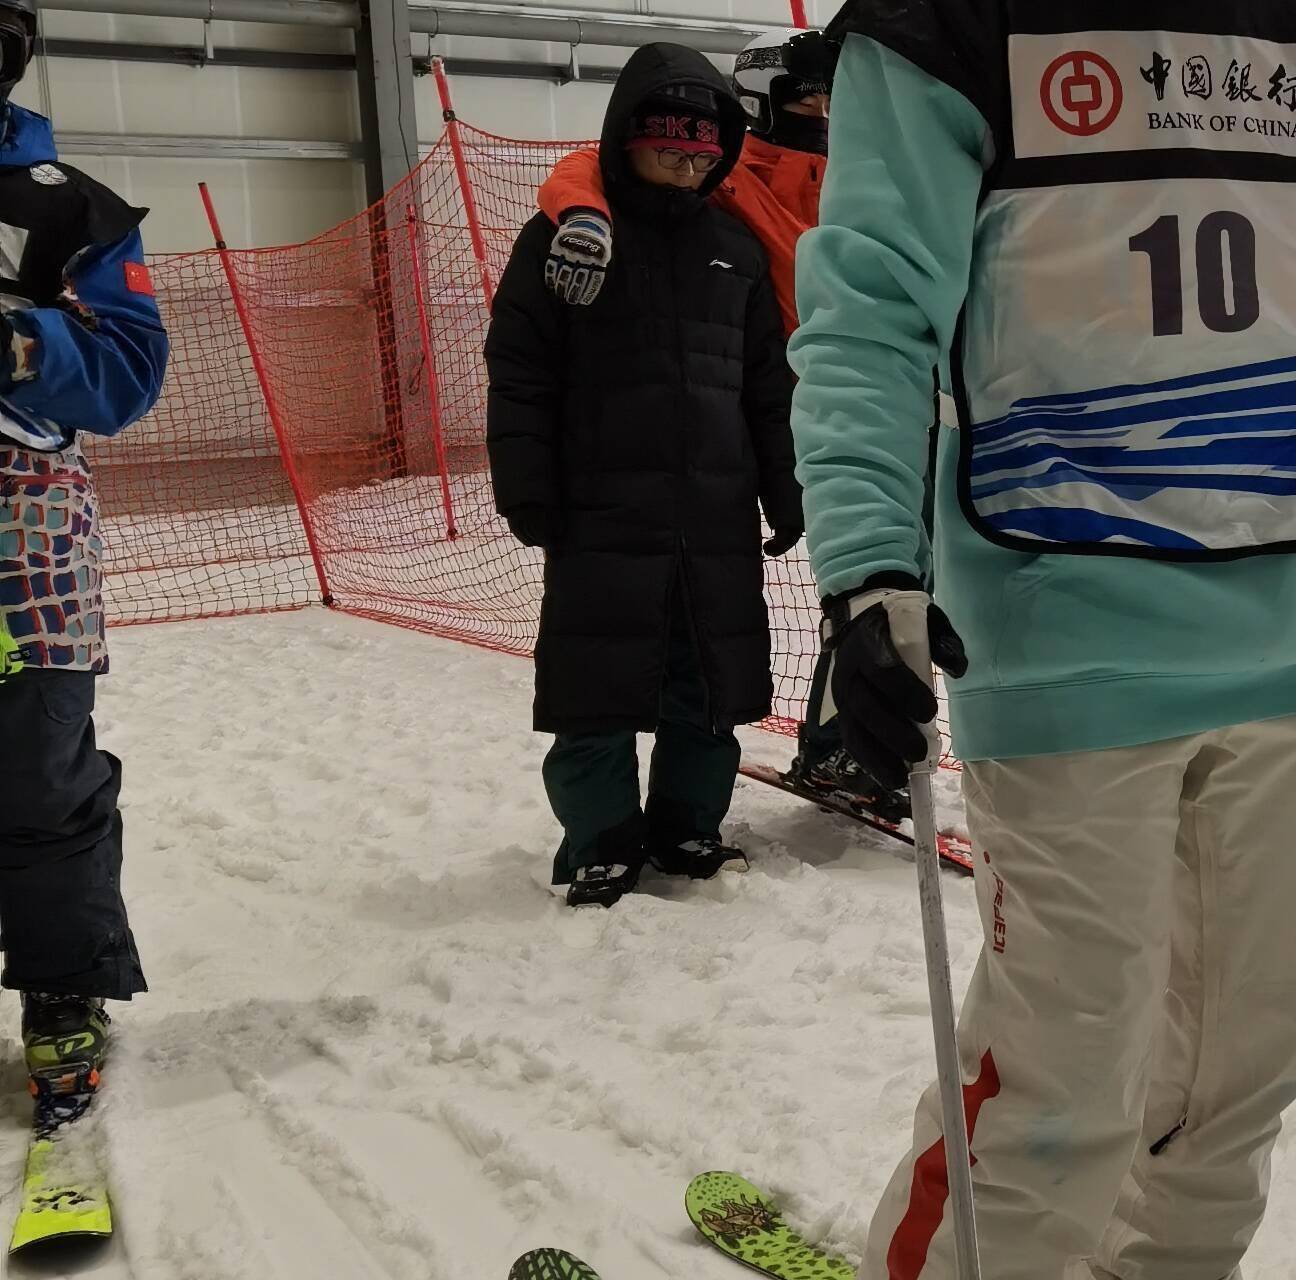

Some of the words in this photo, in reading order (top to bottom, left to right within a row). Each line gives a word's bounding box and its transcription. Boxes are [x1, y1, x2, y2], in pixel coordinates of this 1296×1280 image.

[1147, 111, 1205, 131] BANK
[1209, 114, 1237, 132] OF
[1128, 210, 1260, 337] 10
[993, 871, 1007, 954] ICEPEA
